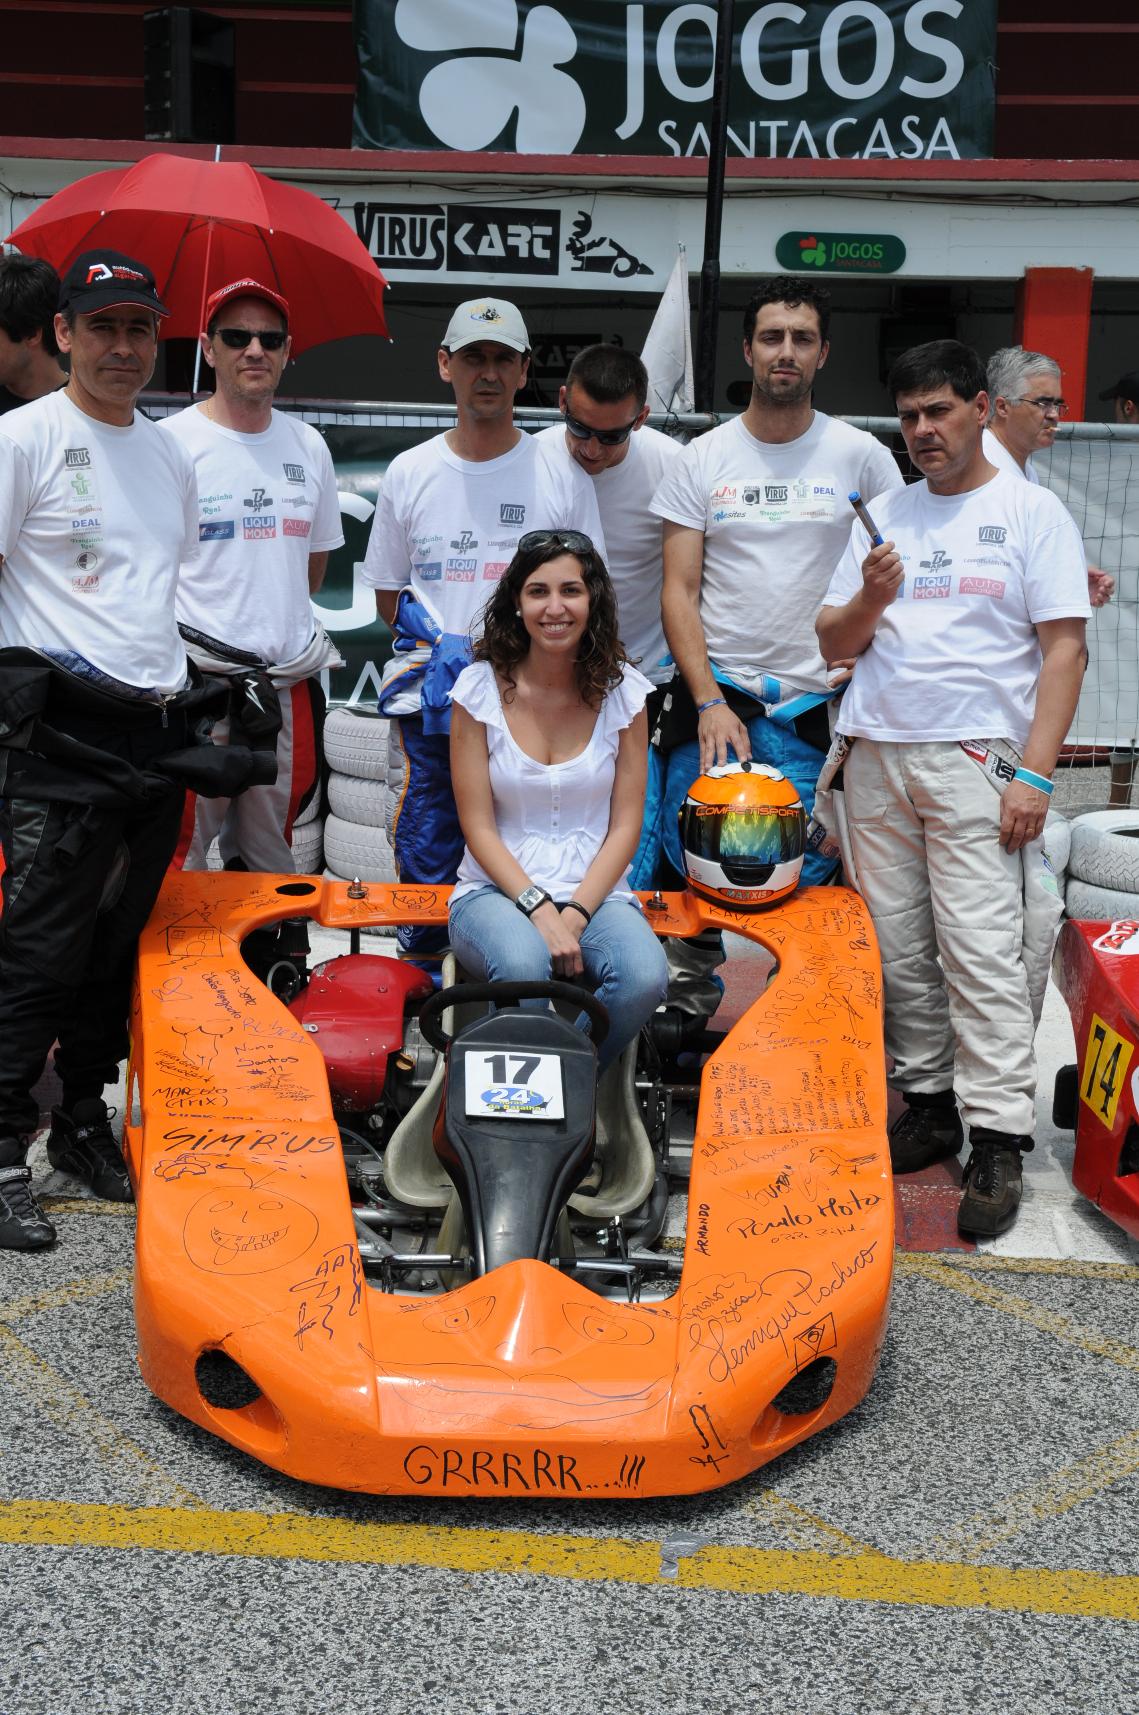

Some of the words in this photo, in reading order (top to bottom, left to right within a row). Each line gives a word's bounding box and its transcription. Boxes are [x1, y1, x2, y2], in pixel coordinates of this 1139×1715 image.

[614, 0, 964, 139] JOGOS
[658, 115, 960, 160] SANTACASA
[354, 202, 445, 270] VIRUS
[454, 223, 552, 259] KART
[831, 242, 883, 262] JOGOS
[65, 448, 90, 467] VIRUS
[283, 464, 305, 483] VIRUS
[764, 485, 788, 503] VIRUS
[813, 486, 836, 495] DEAL
[244, 517, 275, 528] LIQUI
[500, 503, 525, 524] VIRUS
[72, 519, 102, 528] DEAL
[244, 528, 277, 539] MOLY
[979, 526, 1007, 544] VIRUS
[447, 559, 476, 570] LIQUI
[446, 571, 475, 582] MOLY
[916, 576, 949, 587] LIQUI
[914, 587, 949, 598] MOLY
[695, 805, 800, 818] COMPETISPORT
[727, 890, 768, 899] MAXXIS
[484, 1055, 541, 1084] 17
[1086, 1023, 1122, 1119] 74
[490, 1088, 531, 1103] 24
[694, 1203, 711, 1257] ARMANDO
